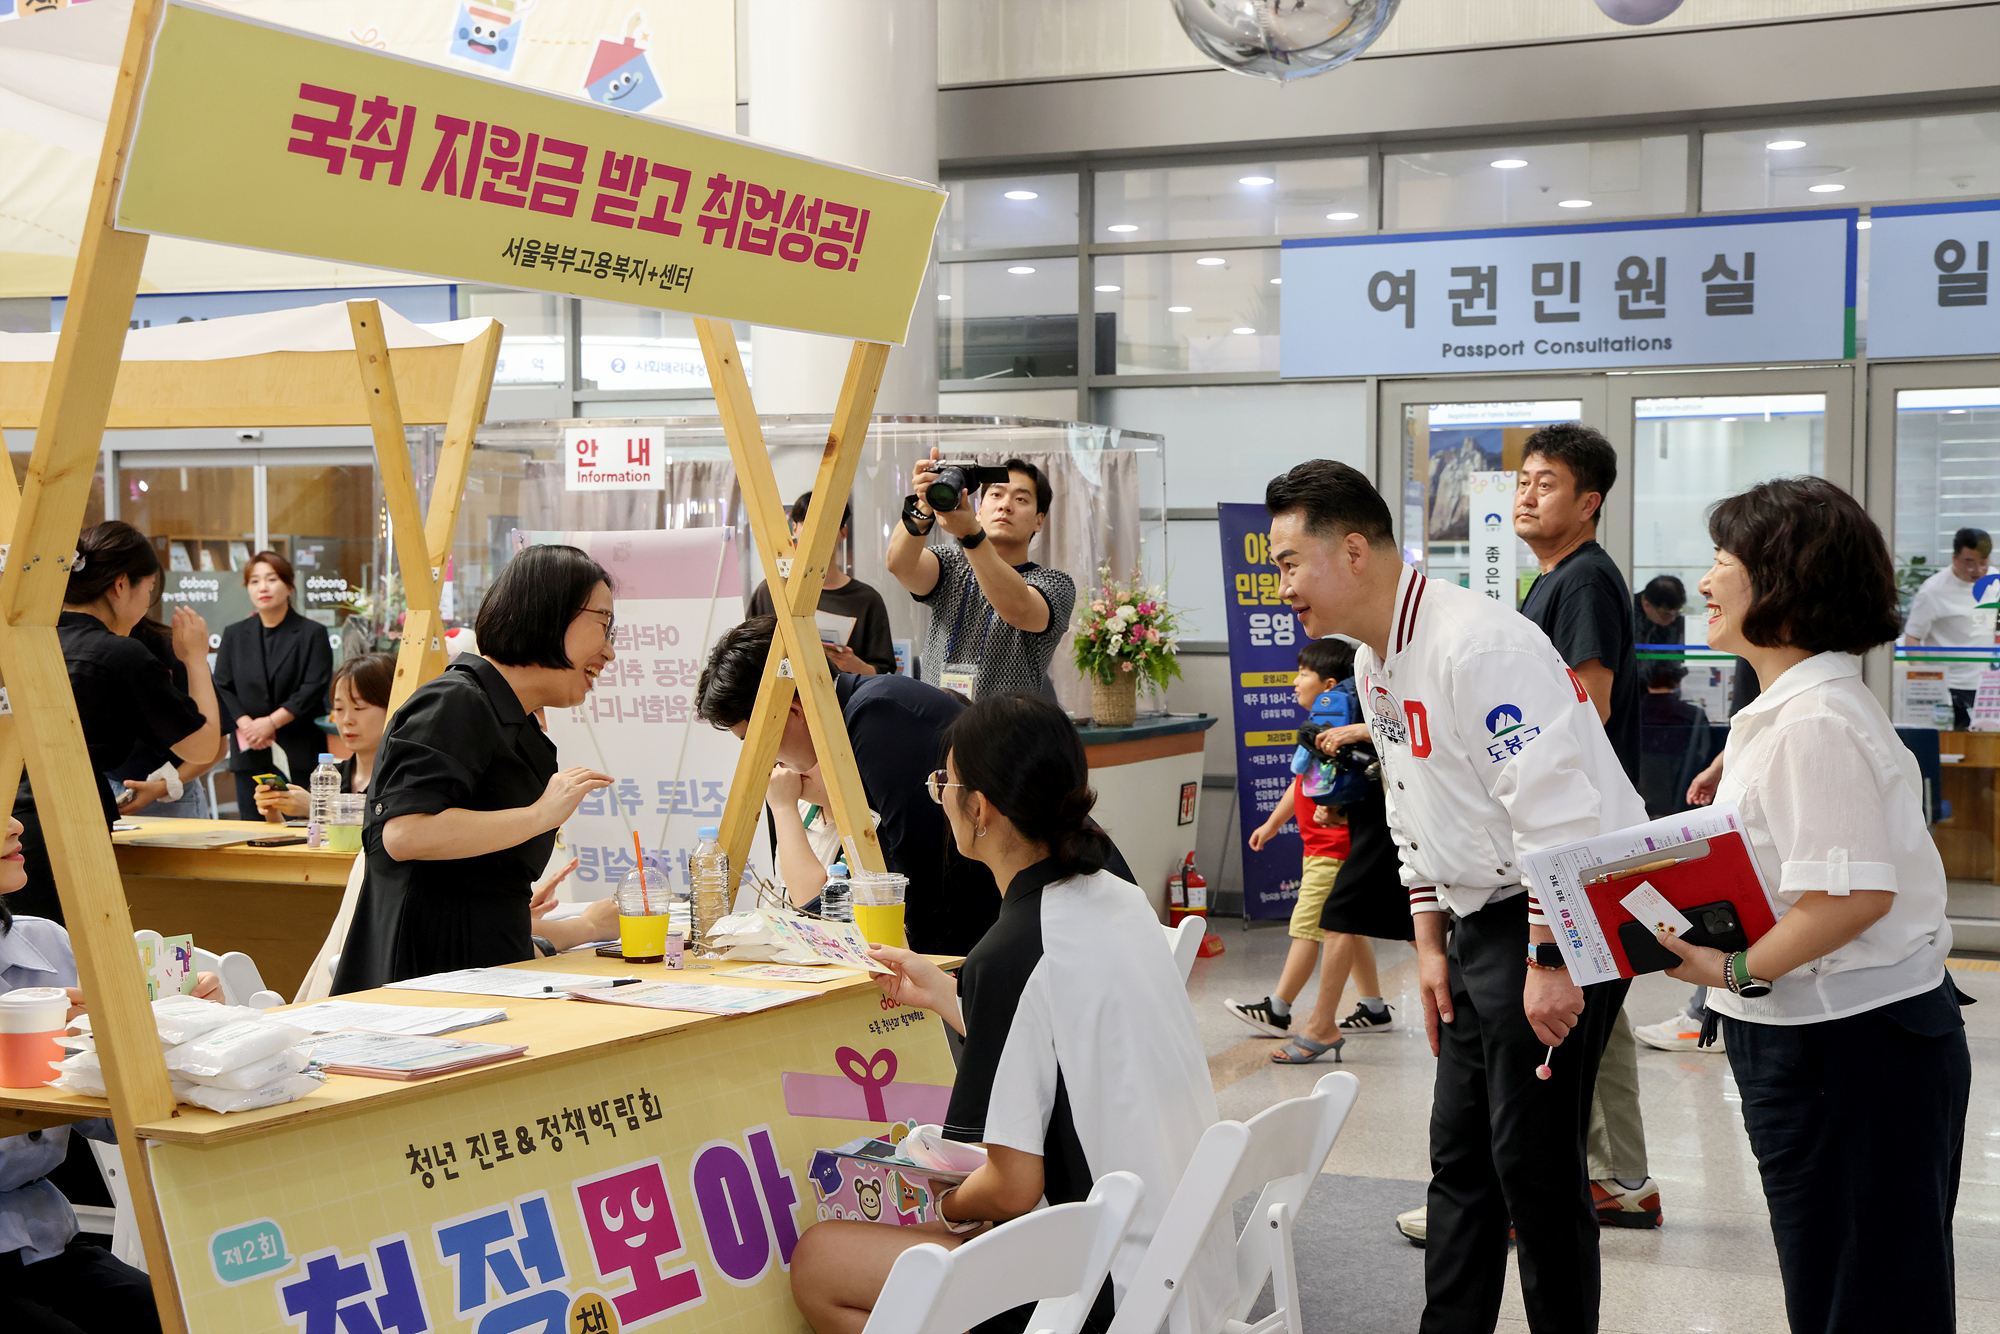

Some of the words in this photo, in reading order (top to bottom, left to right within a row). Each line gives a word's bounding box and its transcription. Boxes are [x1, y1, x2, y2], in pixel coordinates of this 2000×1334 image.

[287, 83, 417, 187] 국취
[421, 113, 589, 218] 지원금
[591, 150, 692, 237] 받고
[697, 173, 870, 272] 취업성공!
[501, 236, 694, 294] 서울북부고용복지+센터
[1934, 239, 1988, 306] 일
[1442, 339, 1525, 360] Passport
[1534, 334, 1673, 354] Consultations
[577, 469, 651, 485] Information
[1244, 532, 1275, 565] 야
[179, 576, 219, 591] dobong
[306, 575, 348, 591] dobong
[1236, 573, 1293, 606] 민원
[1249, 613, 1296, 646] 운영
[1263, 674, 1288, 685] 운영시간
[1404, 700, 1432, 758] D
[406, 1142, 459, 1188] 청년
[469, 1086, 663, 1170] 진로&정책박람회
[221, 1234, 278, 1267] 제2회
